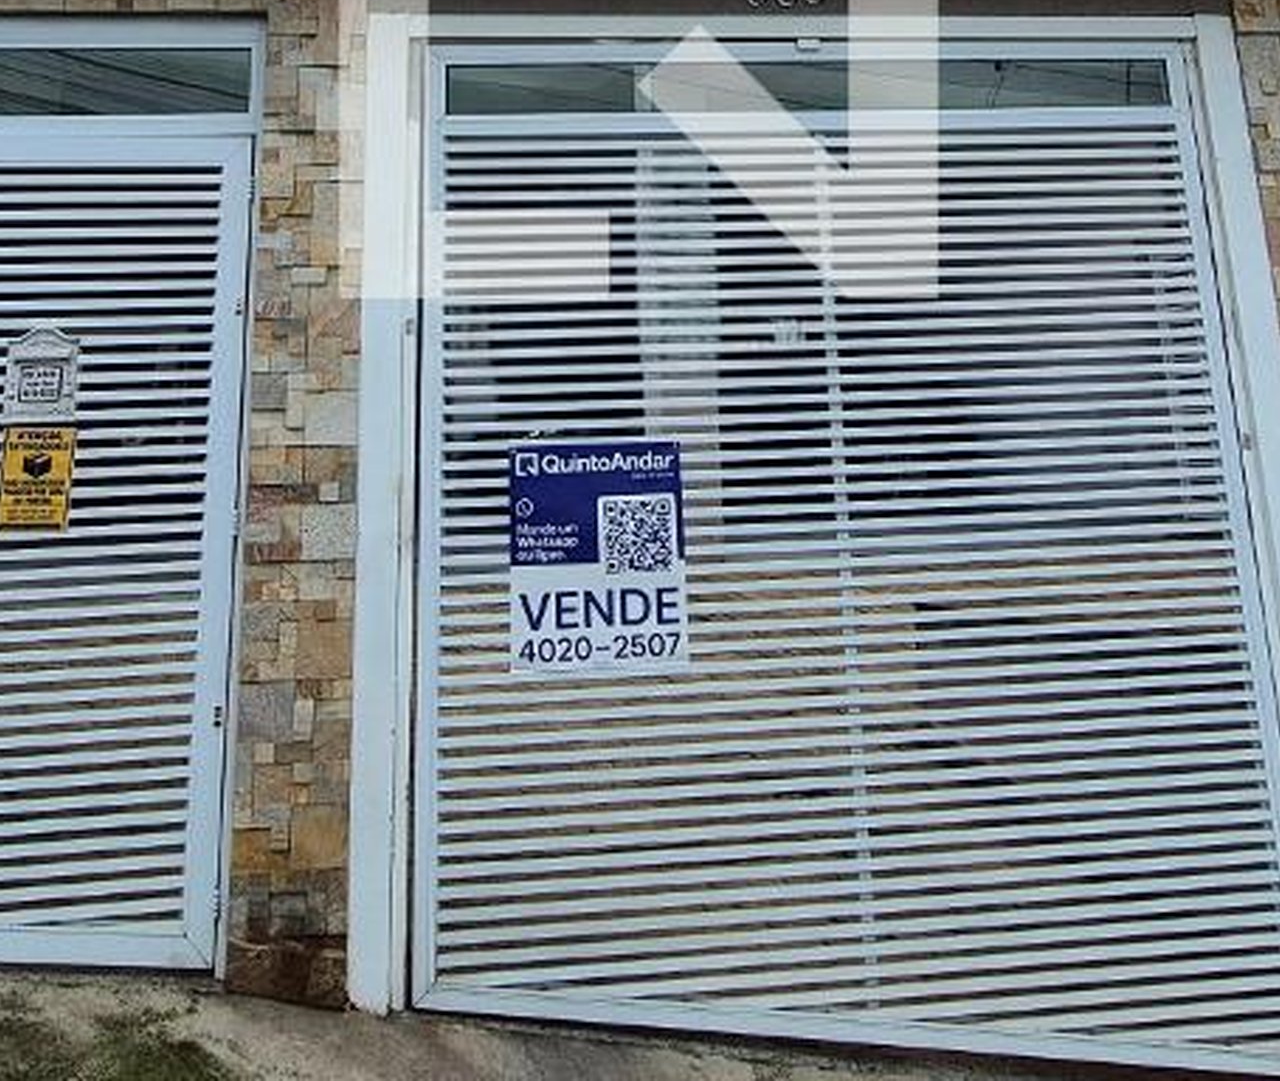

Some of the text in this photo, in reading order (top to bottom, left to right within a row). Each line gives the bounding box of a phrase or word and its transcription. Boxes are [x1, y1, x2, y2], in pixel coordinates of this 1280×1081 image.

[541, 451, 674, 473] QuintoAndar
[519, 587, 681, 631] VENDE
[519, 632, 681, 663] 4020-2507
